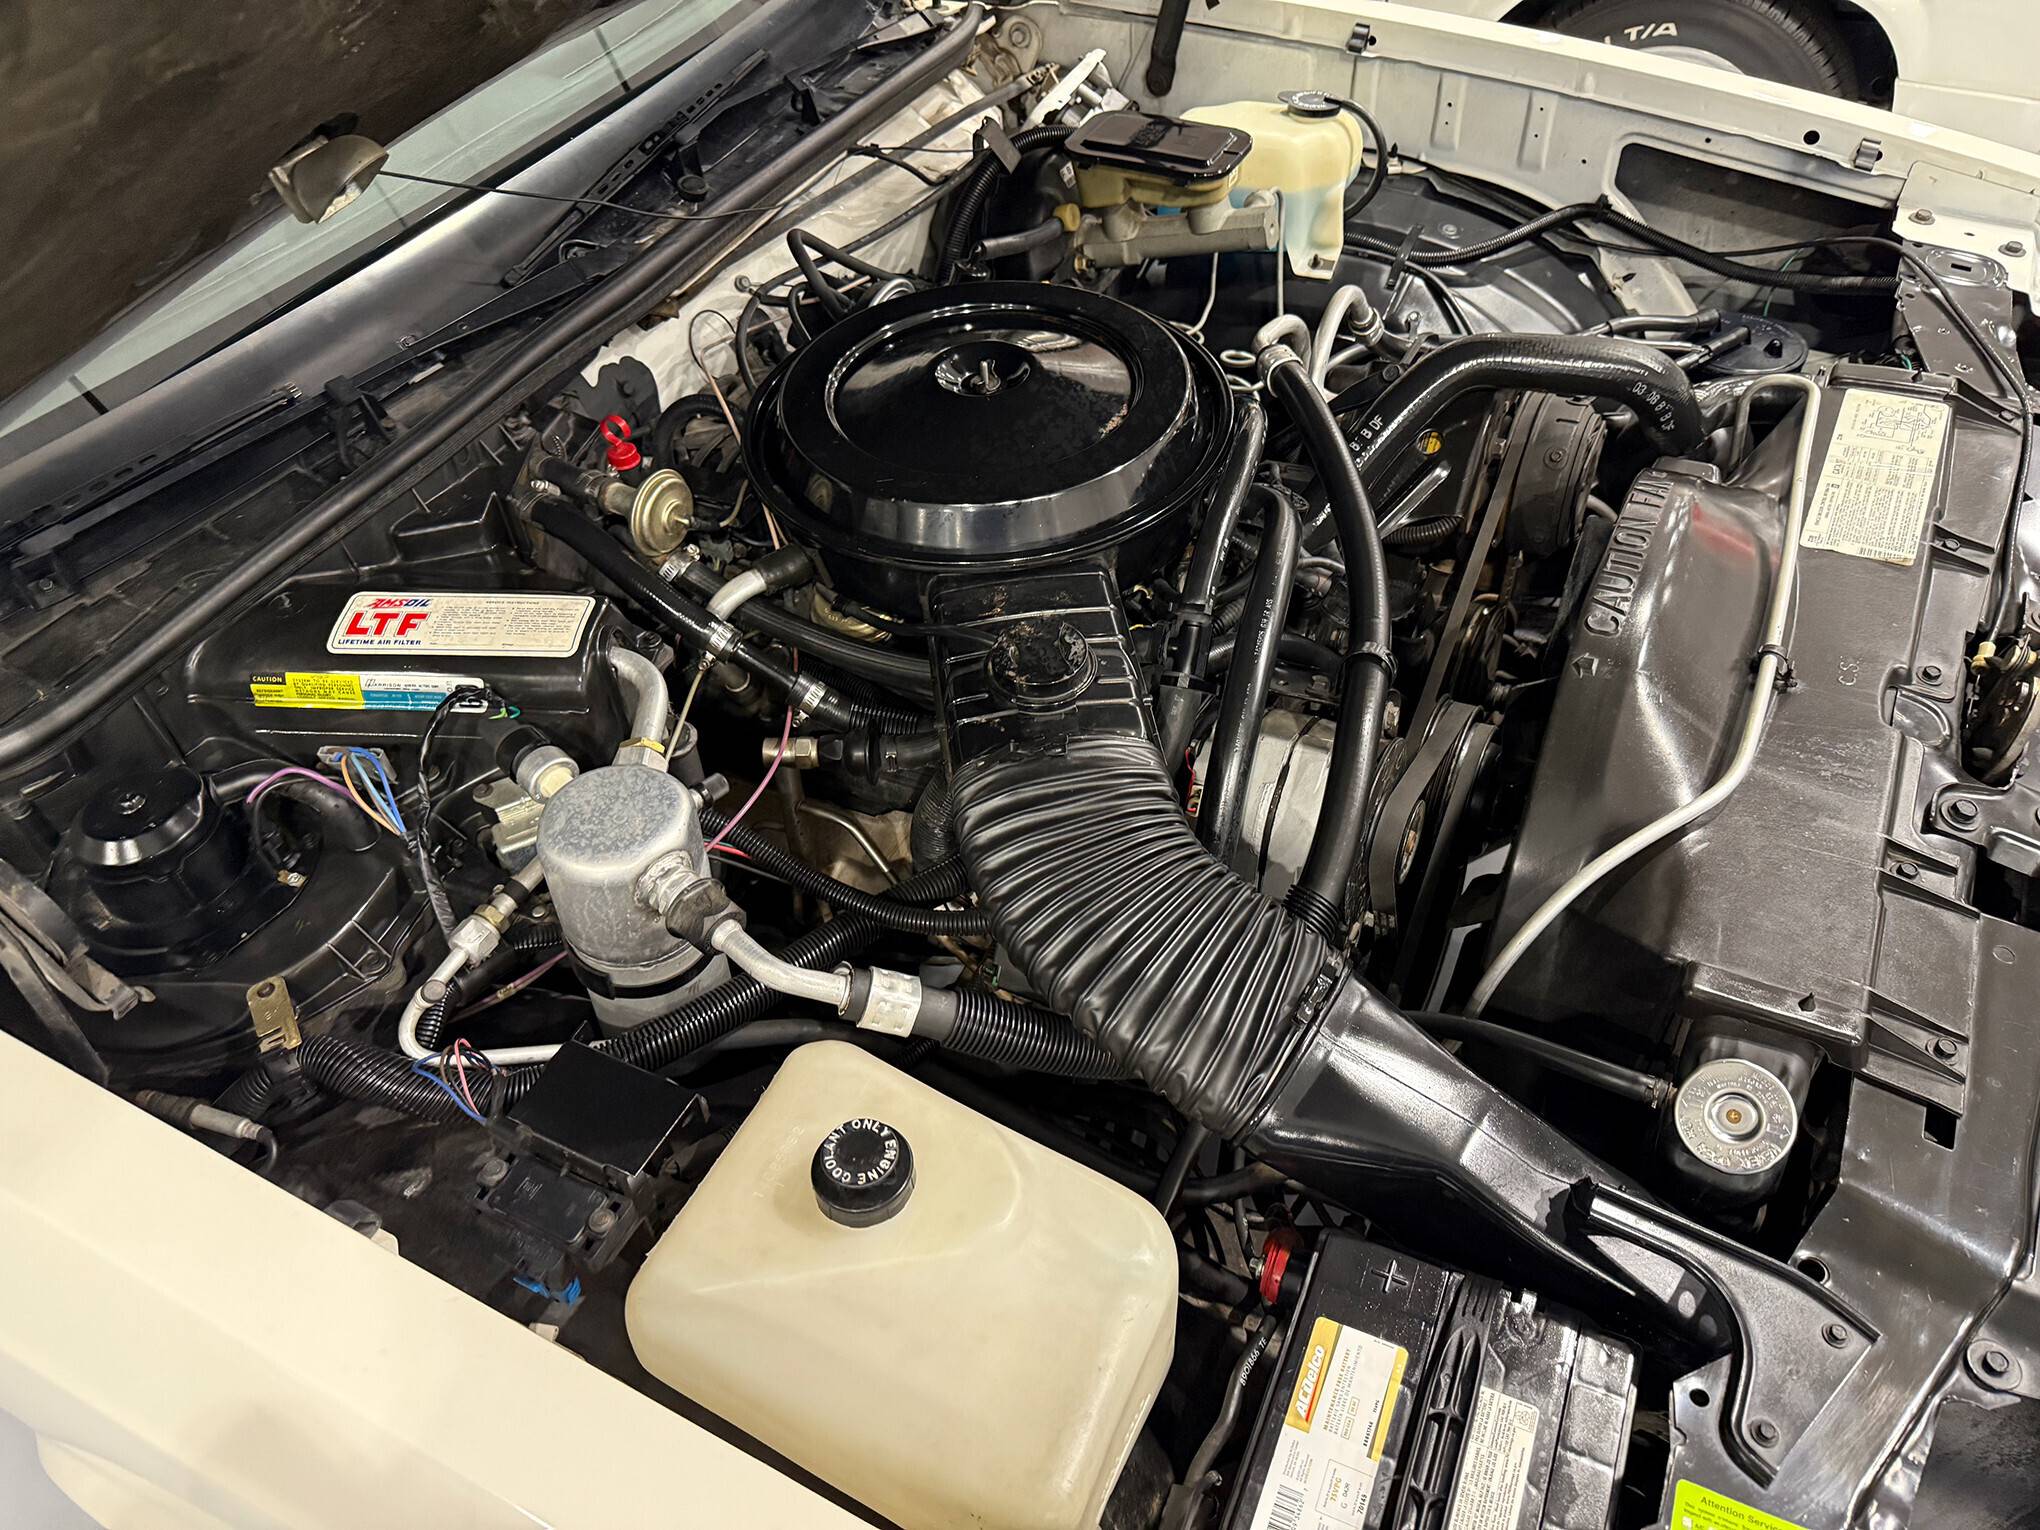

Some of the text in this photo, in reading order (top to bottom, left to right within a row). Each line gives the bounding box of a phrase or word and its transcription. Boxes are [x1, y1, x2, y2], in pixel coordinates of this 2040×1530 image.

[1624, 22, 1678, 42] T/A
[1368, 414, 1383, 431] DF
[1584, 481, 1675, 639] CAUTION FAN
[366, 598, 434, 609] AMSOIL
[344, 611, 431, 637] LTF
[851, 1119, 891, 1137] ONLY
[824, 1123, 852, 1184] COOLANT
[857, 1139, 897, 1185] ENGINE
[1739, 1143, 1782, 1169] NEVER
[1240, 1349, 1260, 1386] 8901866
[1295, 1344, 1326, 1420] ACDelco
[1700, 1497, 1745, 1519] Attention
